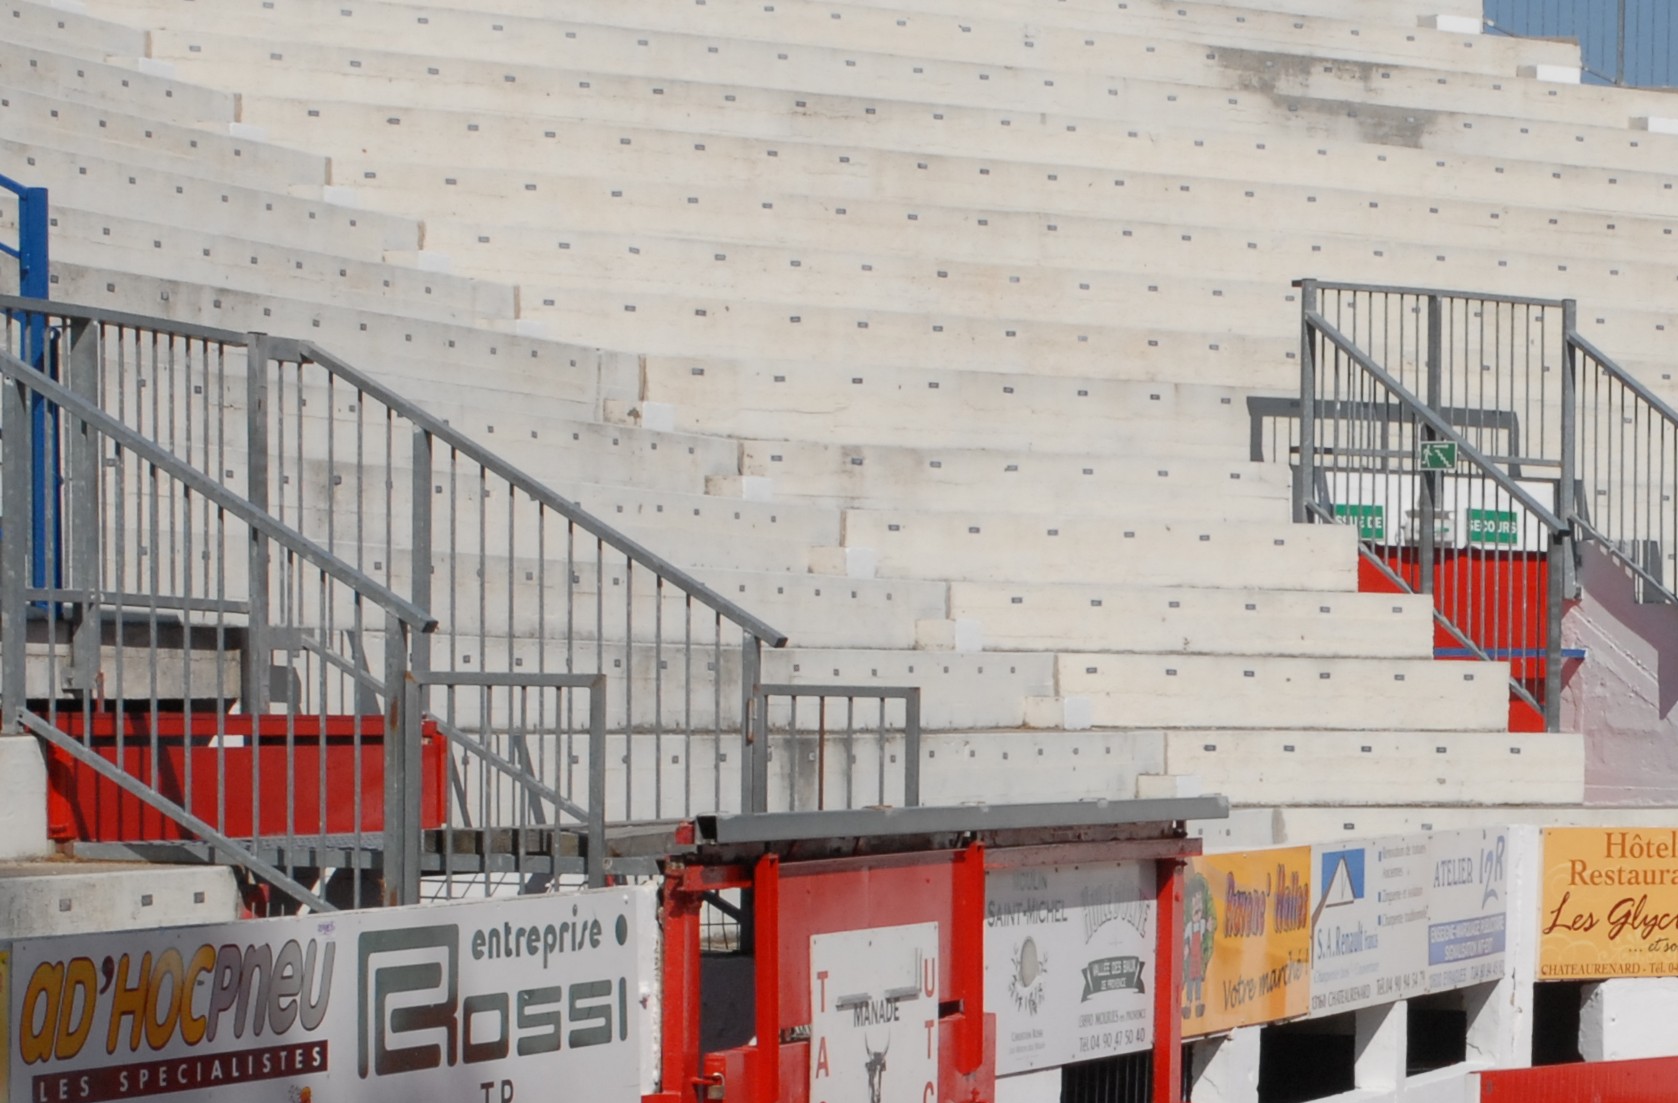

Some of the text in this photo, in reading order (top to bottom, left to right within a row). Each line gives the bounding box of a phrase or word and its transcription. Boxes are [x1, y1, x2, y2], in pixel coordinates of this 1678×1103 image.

[1604, 830, 1677, 858] Hôtel
[1433, 857, 1473, 888] ATELIER
[987, 898, 1068, 927] SAINT-MICHEL
[1543, 891, 1600, 935] Les
[471, 904, 602, 969] entreprise
[1647, 937, 1664, 952] et
[1541, 963, 1640, 976] CHATEAURENARD
[1668, 963, 1678, 974] 04
[1223, 975, 1256, 1011] Votre
[853, 997, 900, 1027] MANADE
[1103, 1032, 1112, 1049] 90
[1125, 1028, 1133, 1045] 50
[1136, 1027, 1145, 1043] 40
[39, 1046, 322, 1103] LES SPECIALISTES
